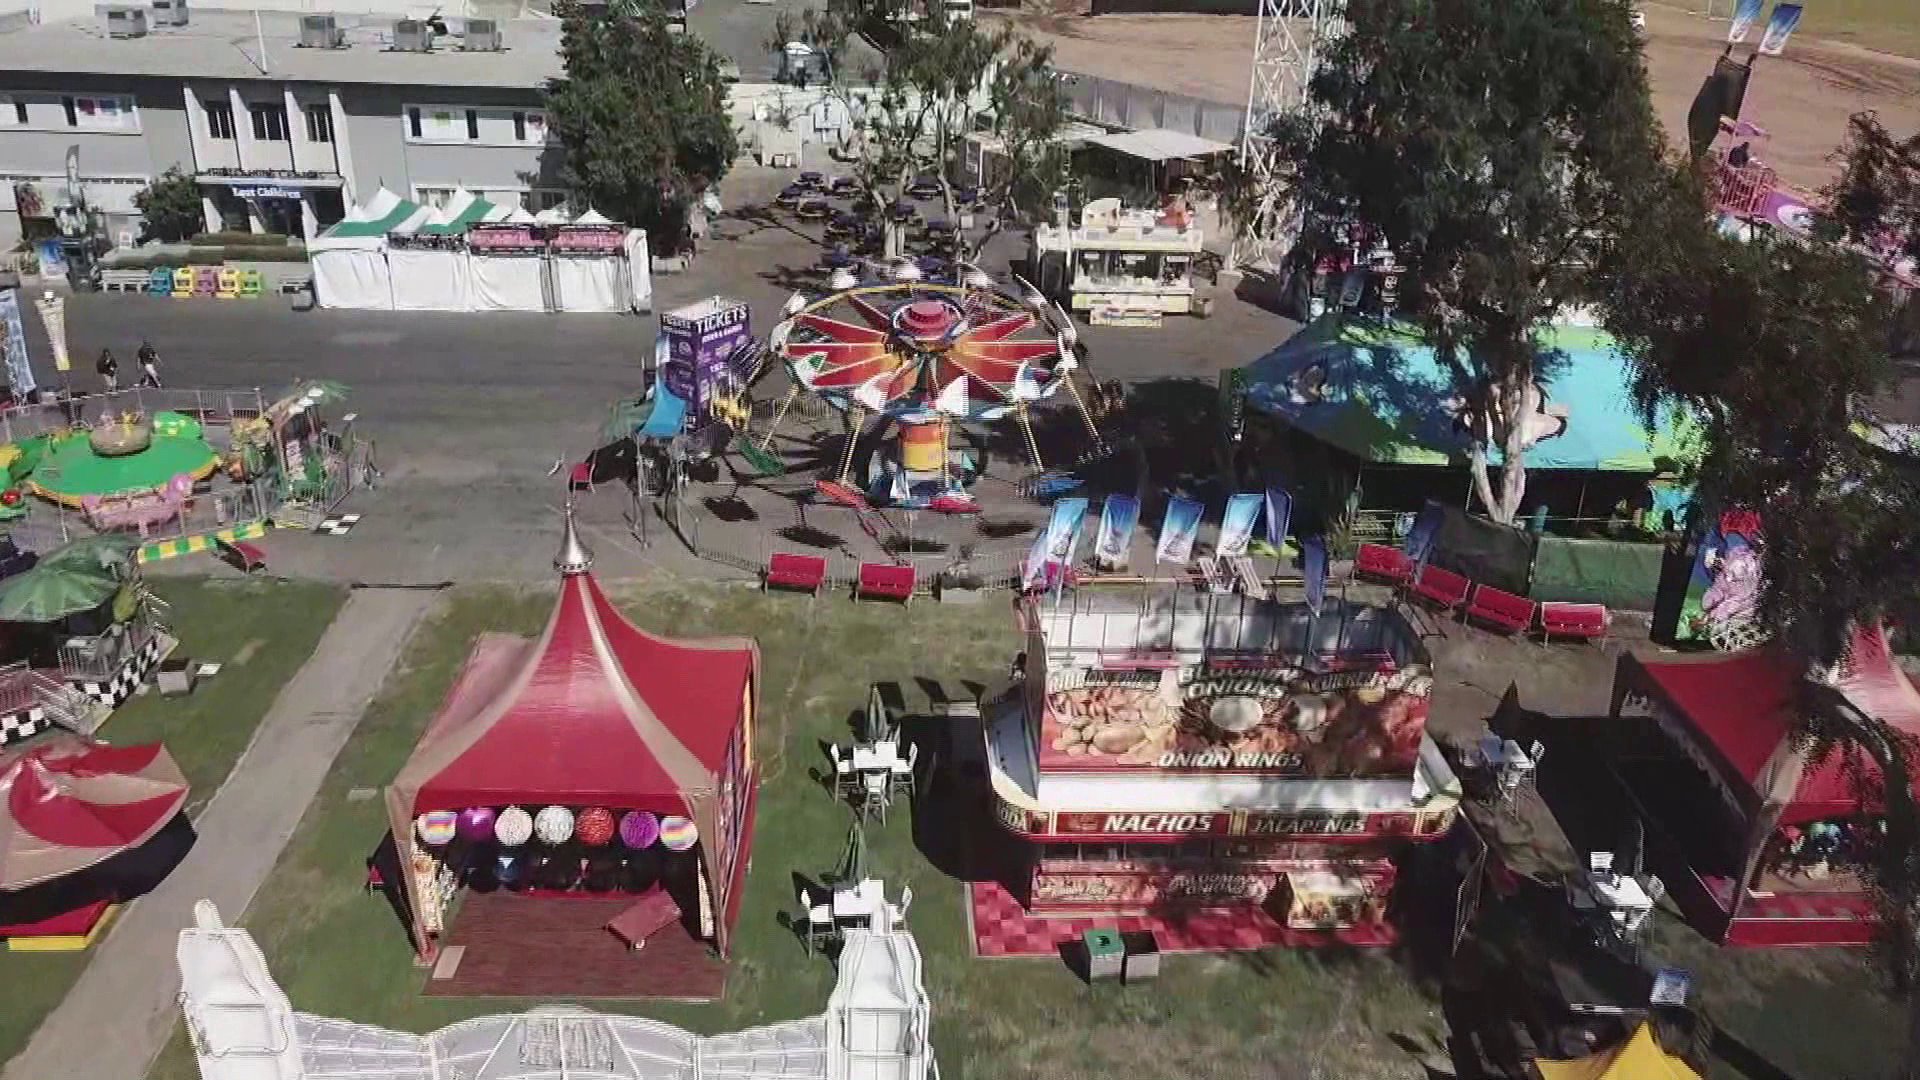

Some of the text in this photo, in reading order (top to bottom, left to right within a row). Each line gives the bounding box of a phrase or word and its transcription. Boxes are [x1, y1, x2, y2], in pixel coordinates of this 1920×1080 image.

[696, 304, 748, 334] TICKETS
[1158, 750, 1302, 767] ONION RINGS
[1104, 814, 1214, 832] NACHOS
